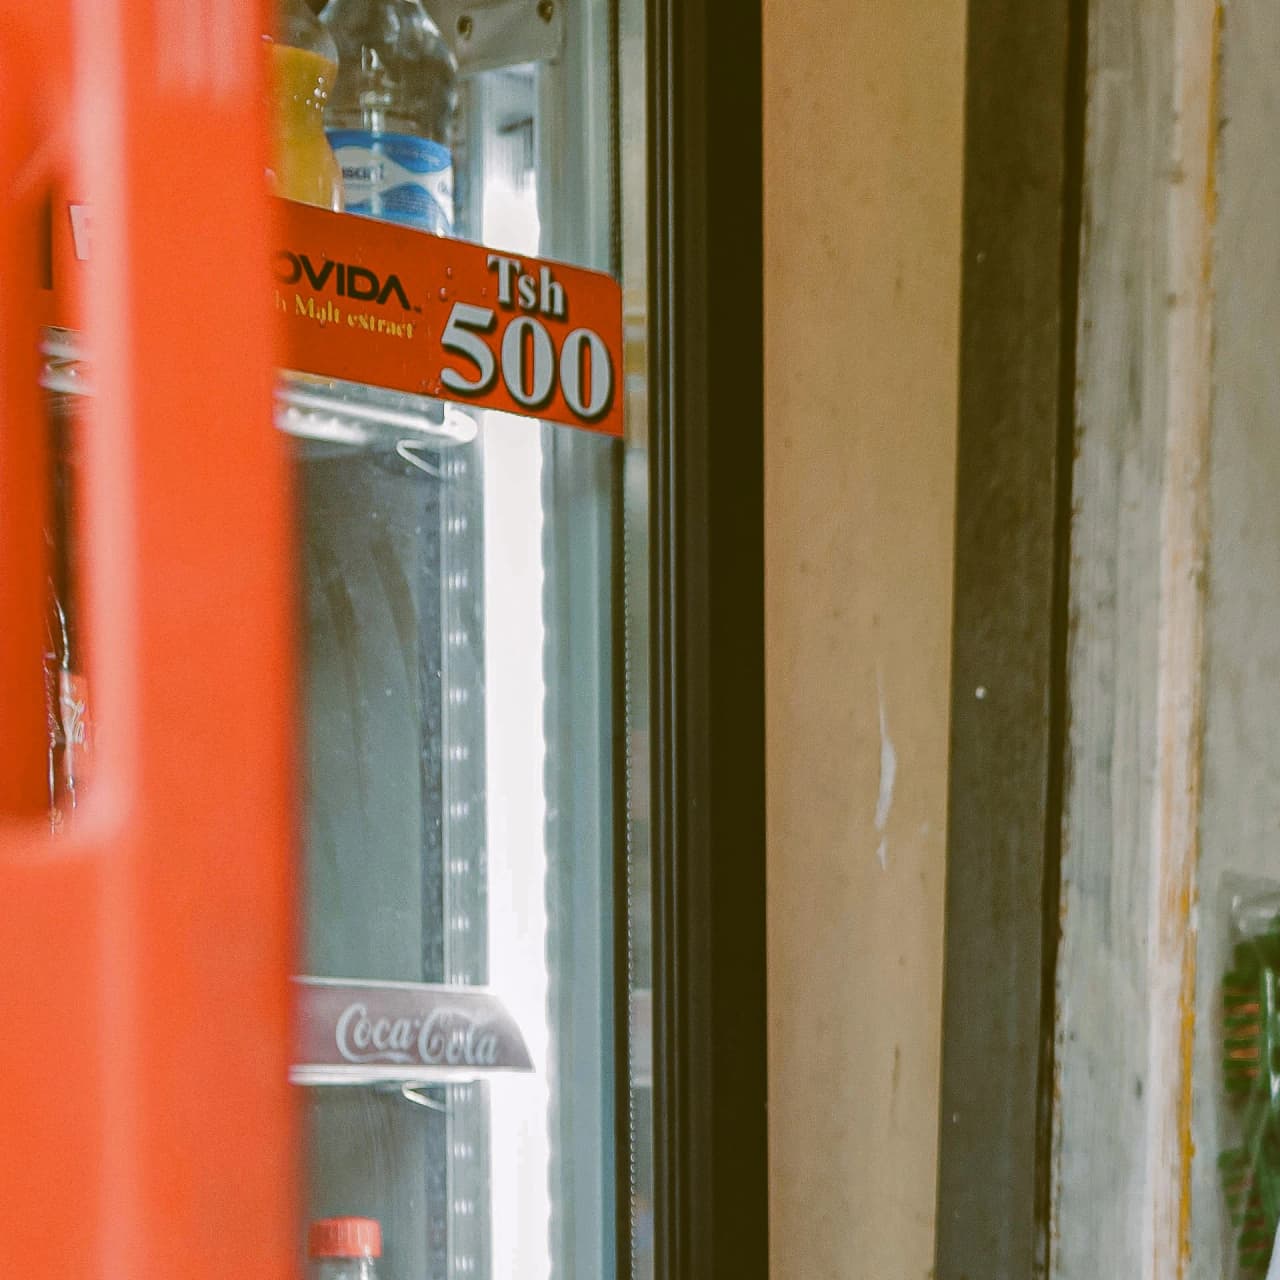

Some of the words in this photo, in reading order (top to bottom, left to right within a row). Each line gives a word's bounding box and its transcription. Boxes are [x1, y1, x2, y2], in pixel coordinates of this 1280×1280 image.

[278, 250, 411, 312] OVIDA
[487, 254, 566, 316] Tsh
[295, 293, 341, 326] Malt
[347, 310, 414, 339] extract
[440, 302, 614, 419] 500
